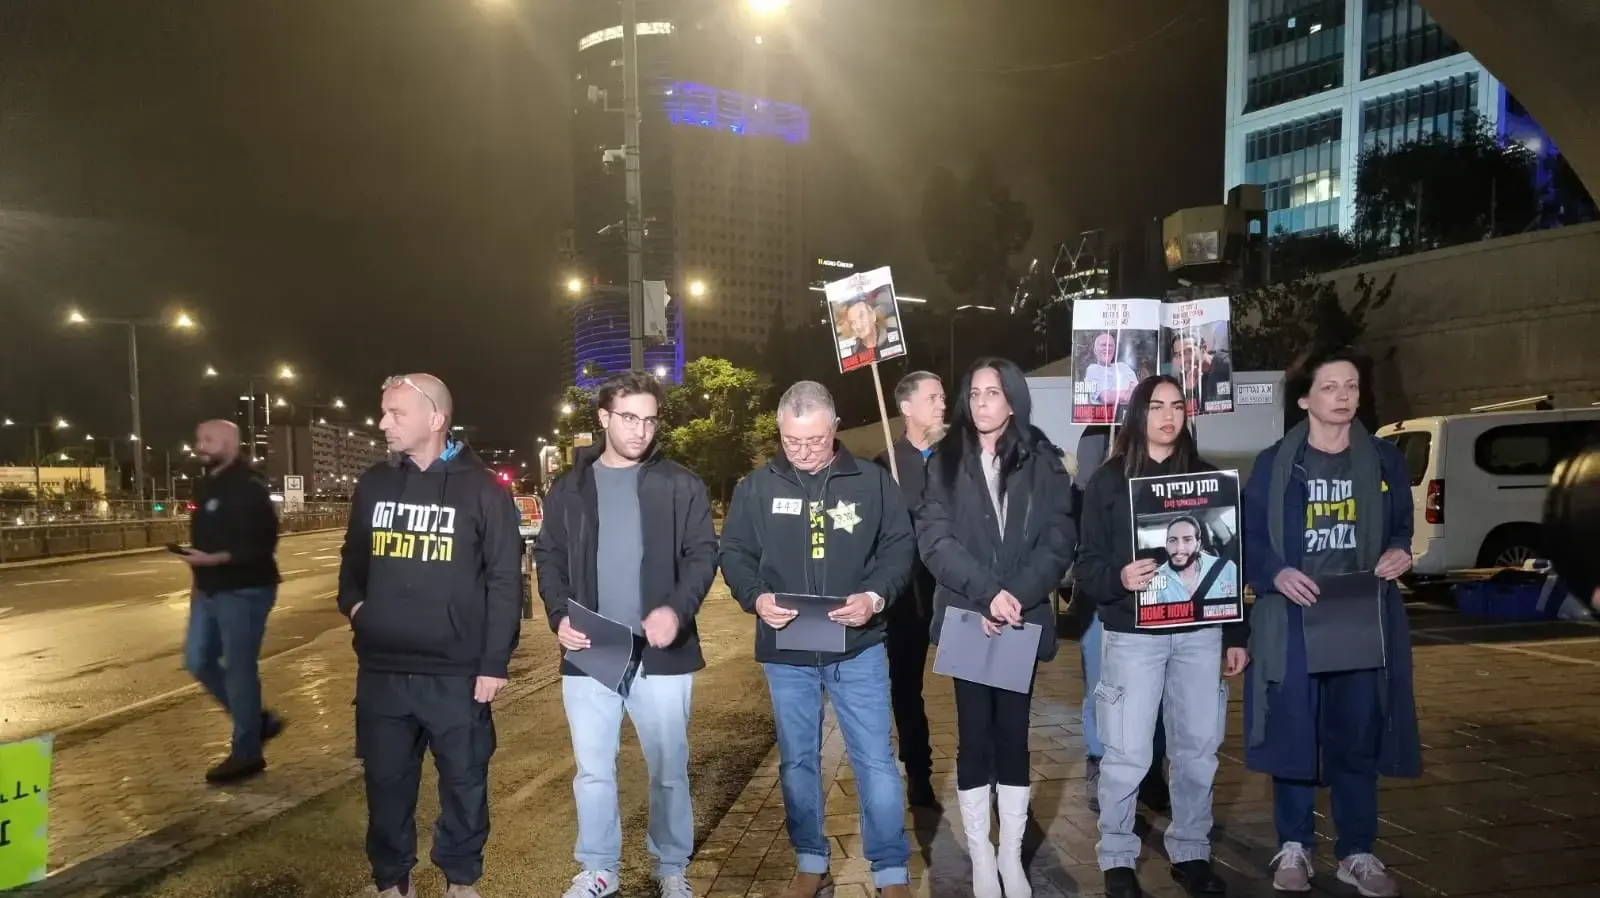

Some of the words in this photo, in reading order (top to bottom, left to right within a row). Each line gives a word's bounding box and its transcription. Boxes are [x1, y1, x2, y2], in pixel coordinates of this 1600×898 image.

[1151, 483, 1165, 497] חי
[1166, 481, 1194, 499] עדיין
[1196, 479, 1218, 497] מתן
[775, 500, 800, 513] 442
[372, 531, 415, 559] הבית!
[419, 533, 453, 562] הלך
[1140, 590, 1158, 606] HIM
[1141, 604, 1165, 621] HOME
[1167, 600, 1194, 619] NOW!
